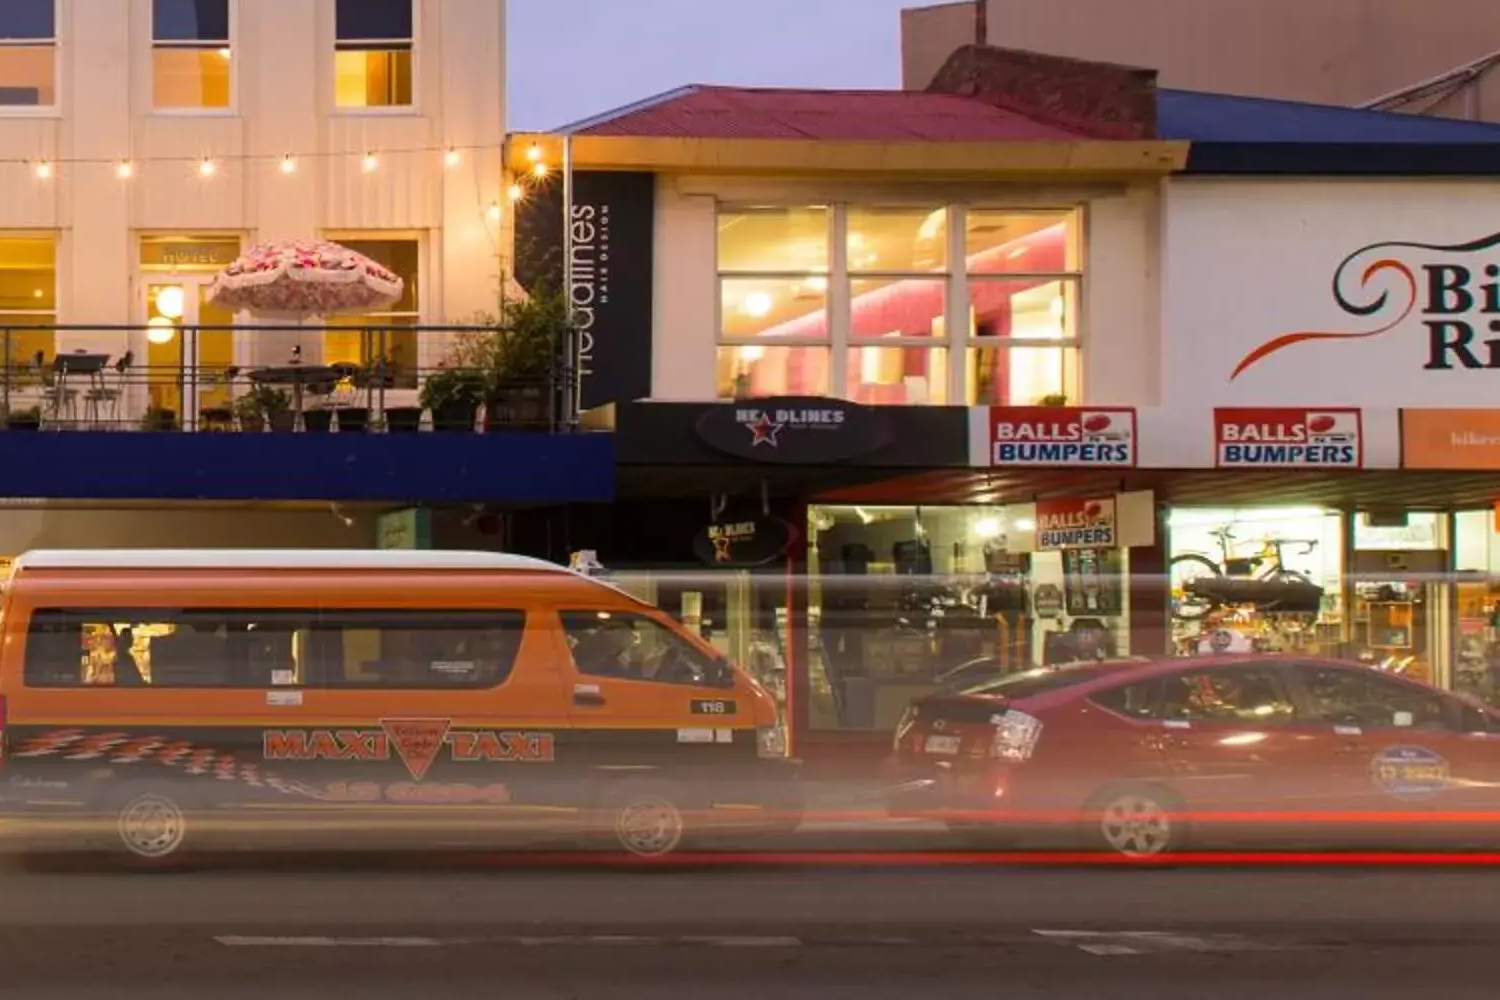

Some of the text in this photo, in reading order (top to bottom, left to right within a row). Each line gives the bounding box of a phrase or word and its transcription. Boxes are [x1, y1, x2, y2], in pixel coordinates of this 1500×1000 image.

[997, 423, 1081, 440] BALLS
[1222, 424, 1305, 441] BALLS
[999, 443, 1128, 461] BUMPERS
[1224, 445, 1354, 463] BUMPERS
[1039, 511, 1085, 529] BALLS
[1041, 528, 1112, 546] BUMPERS
[263, 730, 555, 761] MAXI TAXI
